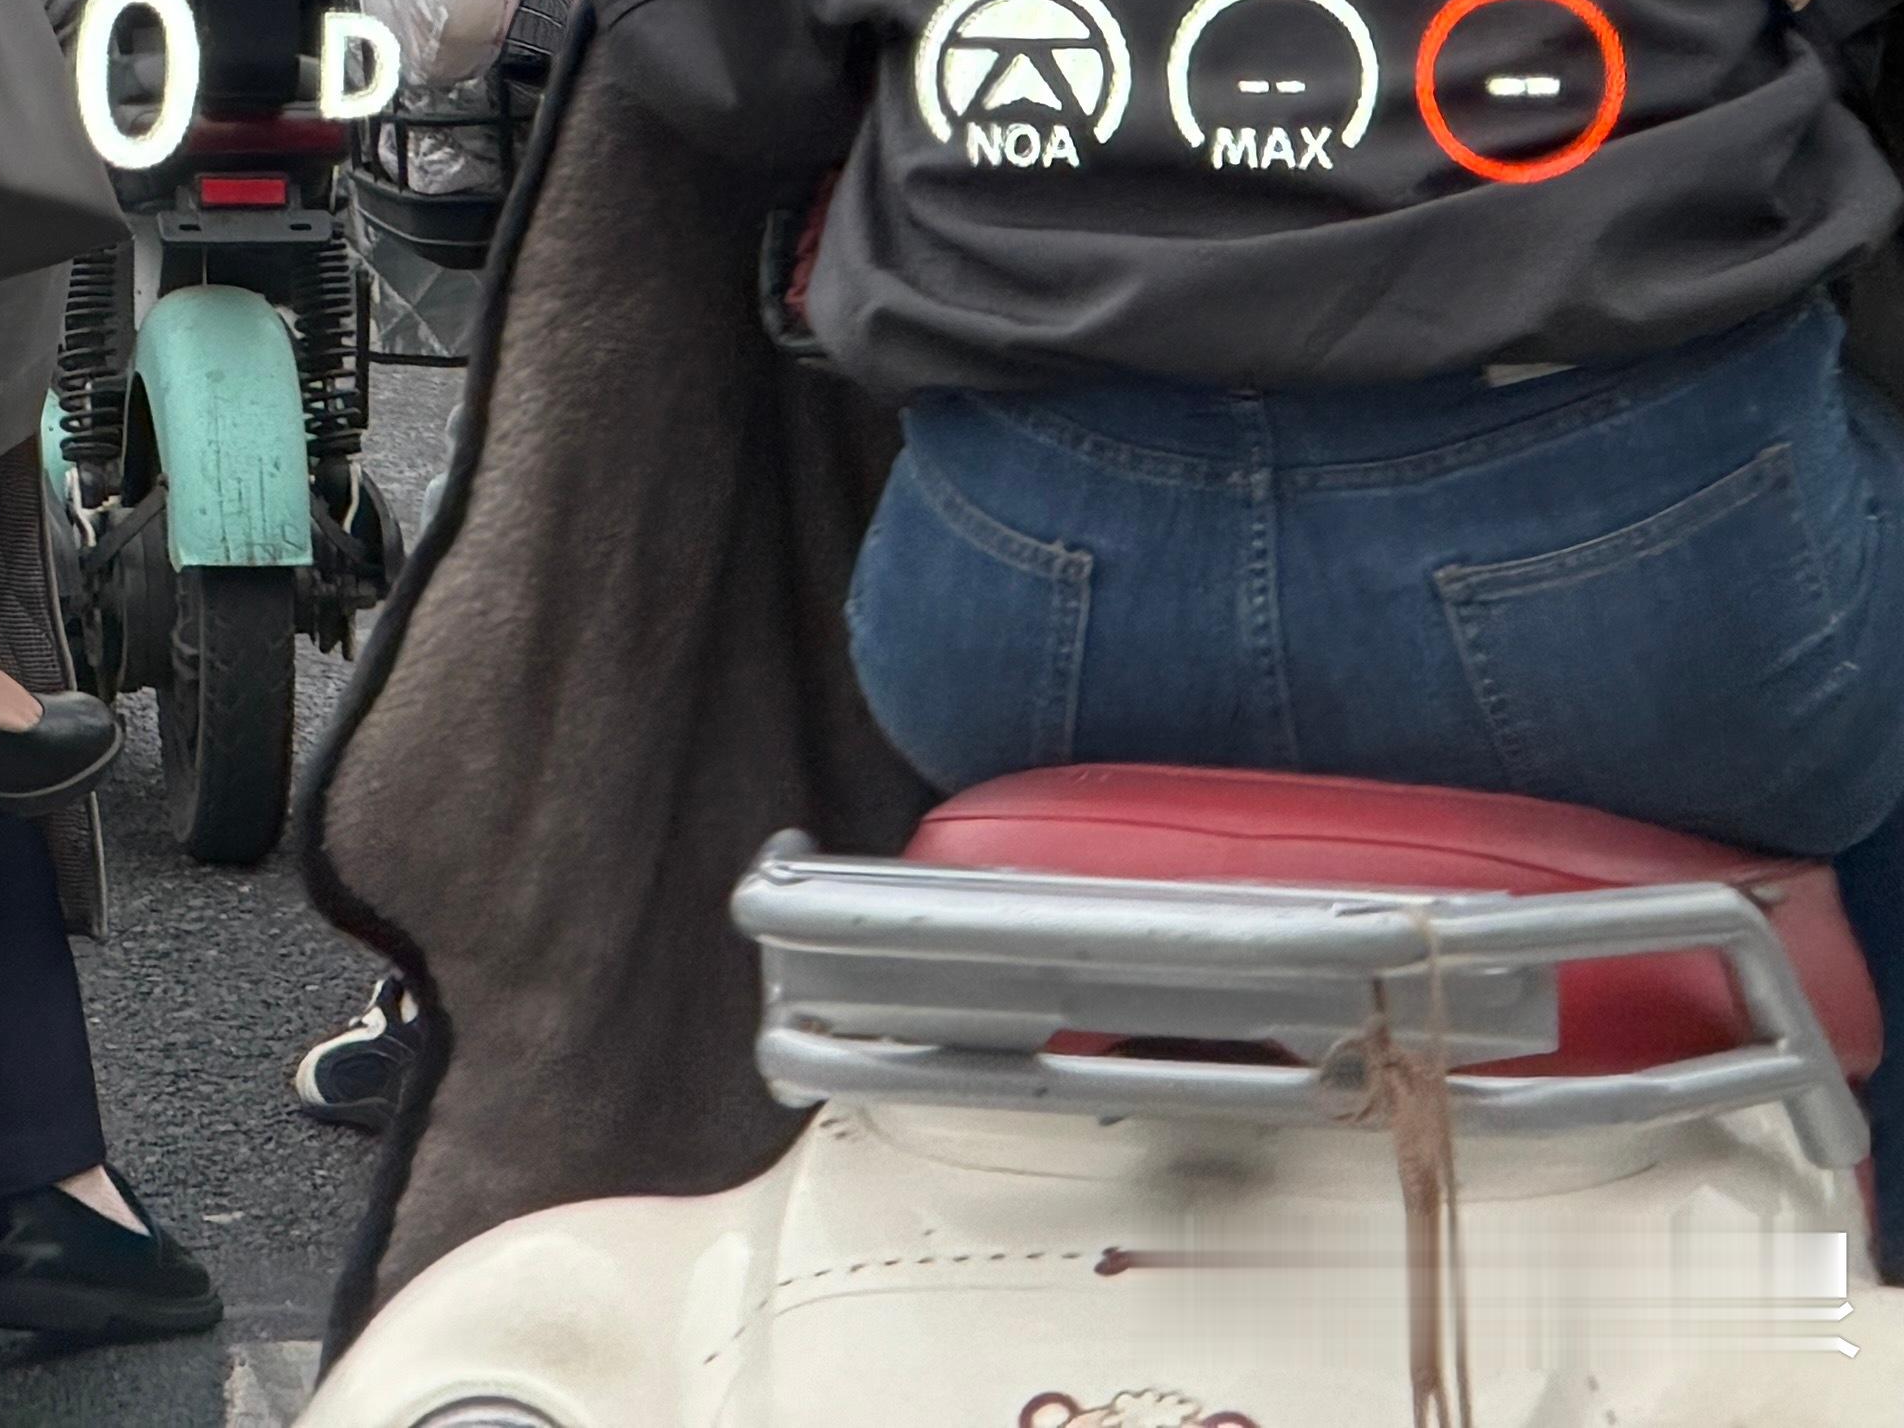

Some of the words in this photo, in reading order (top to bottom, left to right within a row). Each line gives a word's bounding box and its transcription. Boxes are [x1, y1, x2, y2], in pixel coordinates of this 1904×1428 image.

[319, 10, 402, 121] D
[965, 122, 1081, 169] NOA
[1211, 124, 1334, 170] MAX
